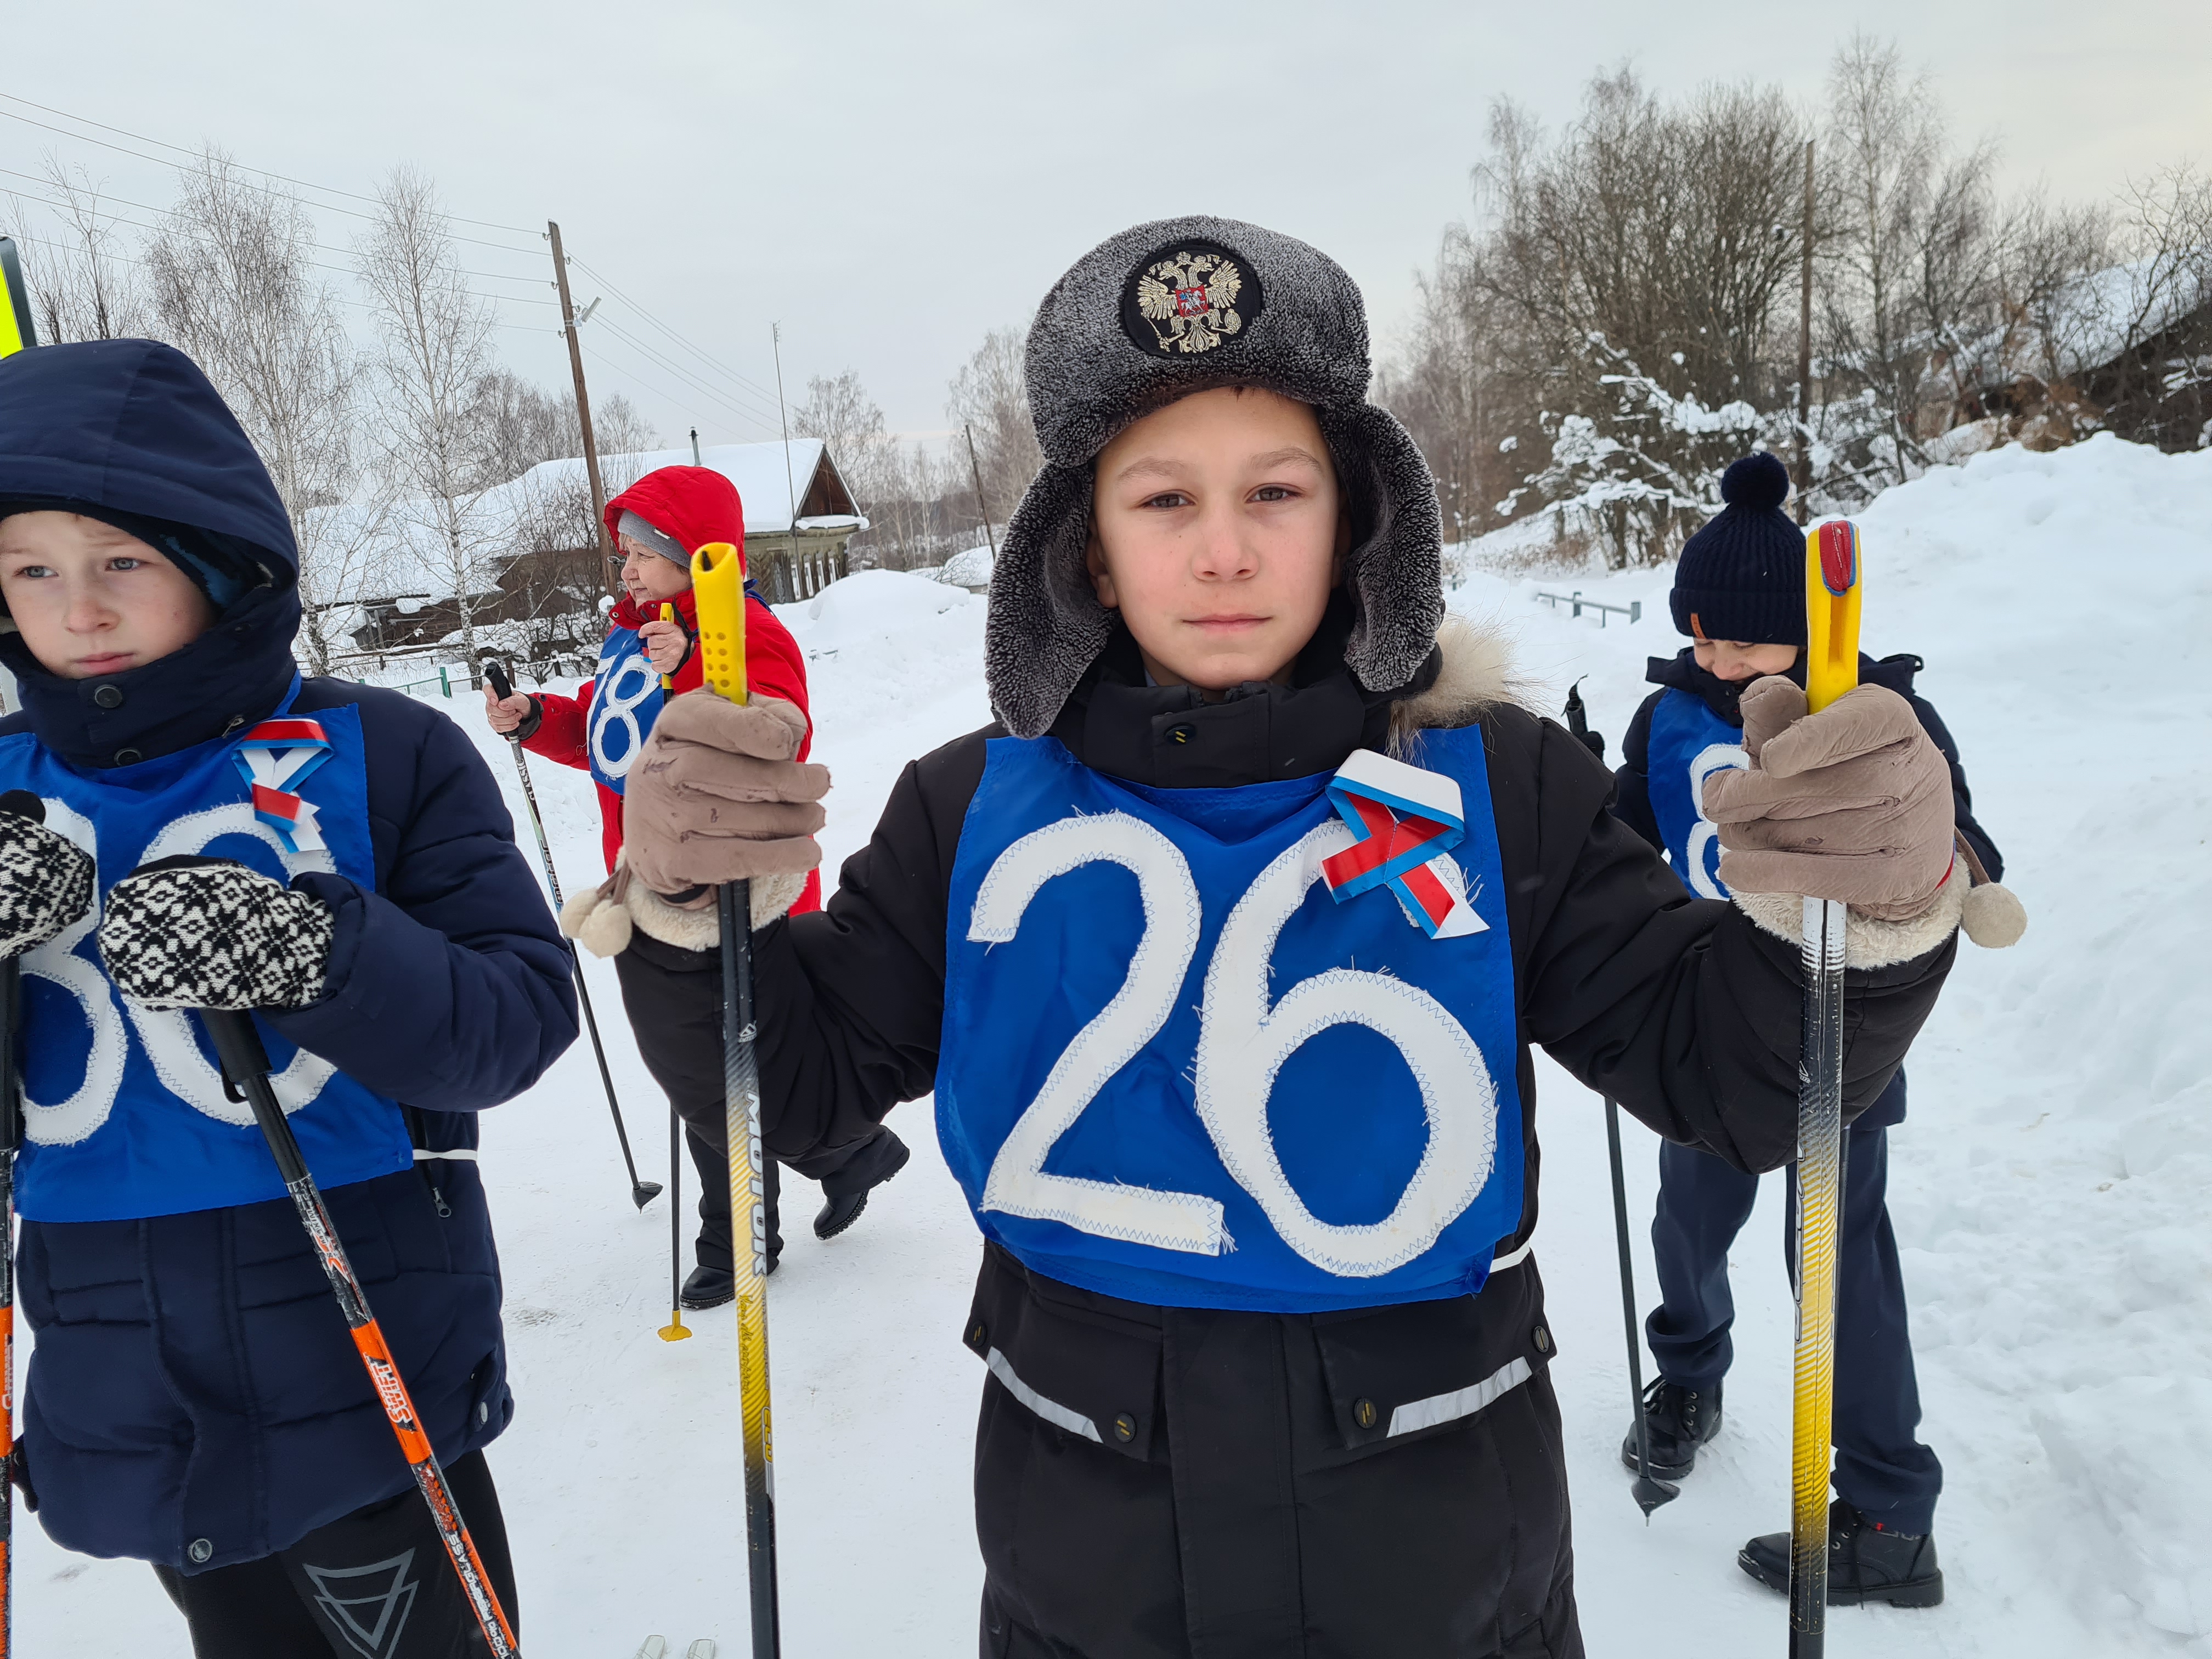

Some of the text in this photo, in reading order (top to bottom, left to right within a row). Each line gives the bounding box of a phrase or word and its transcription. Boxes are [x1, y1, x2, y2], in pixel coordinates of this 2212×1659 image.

[967, 808, 1497, 1278] 26
[744, 1090, 768, 1278] MOTOR
[370, 1359, 413, 1424] SWIFT
